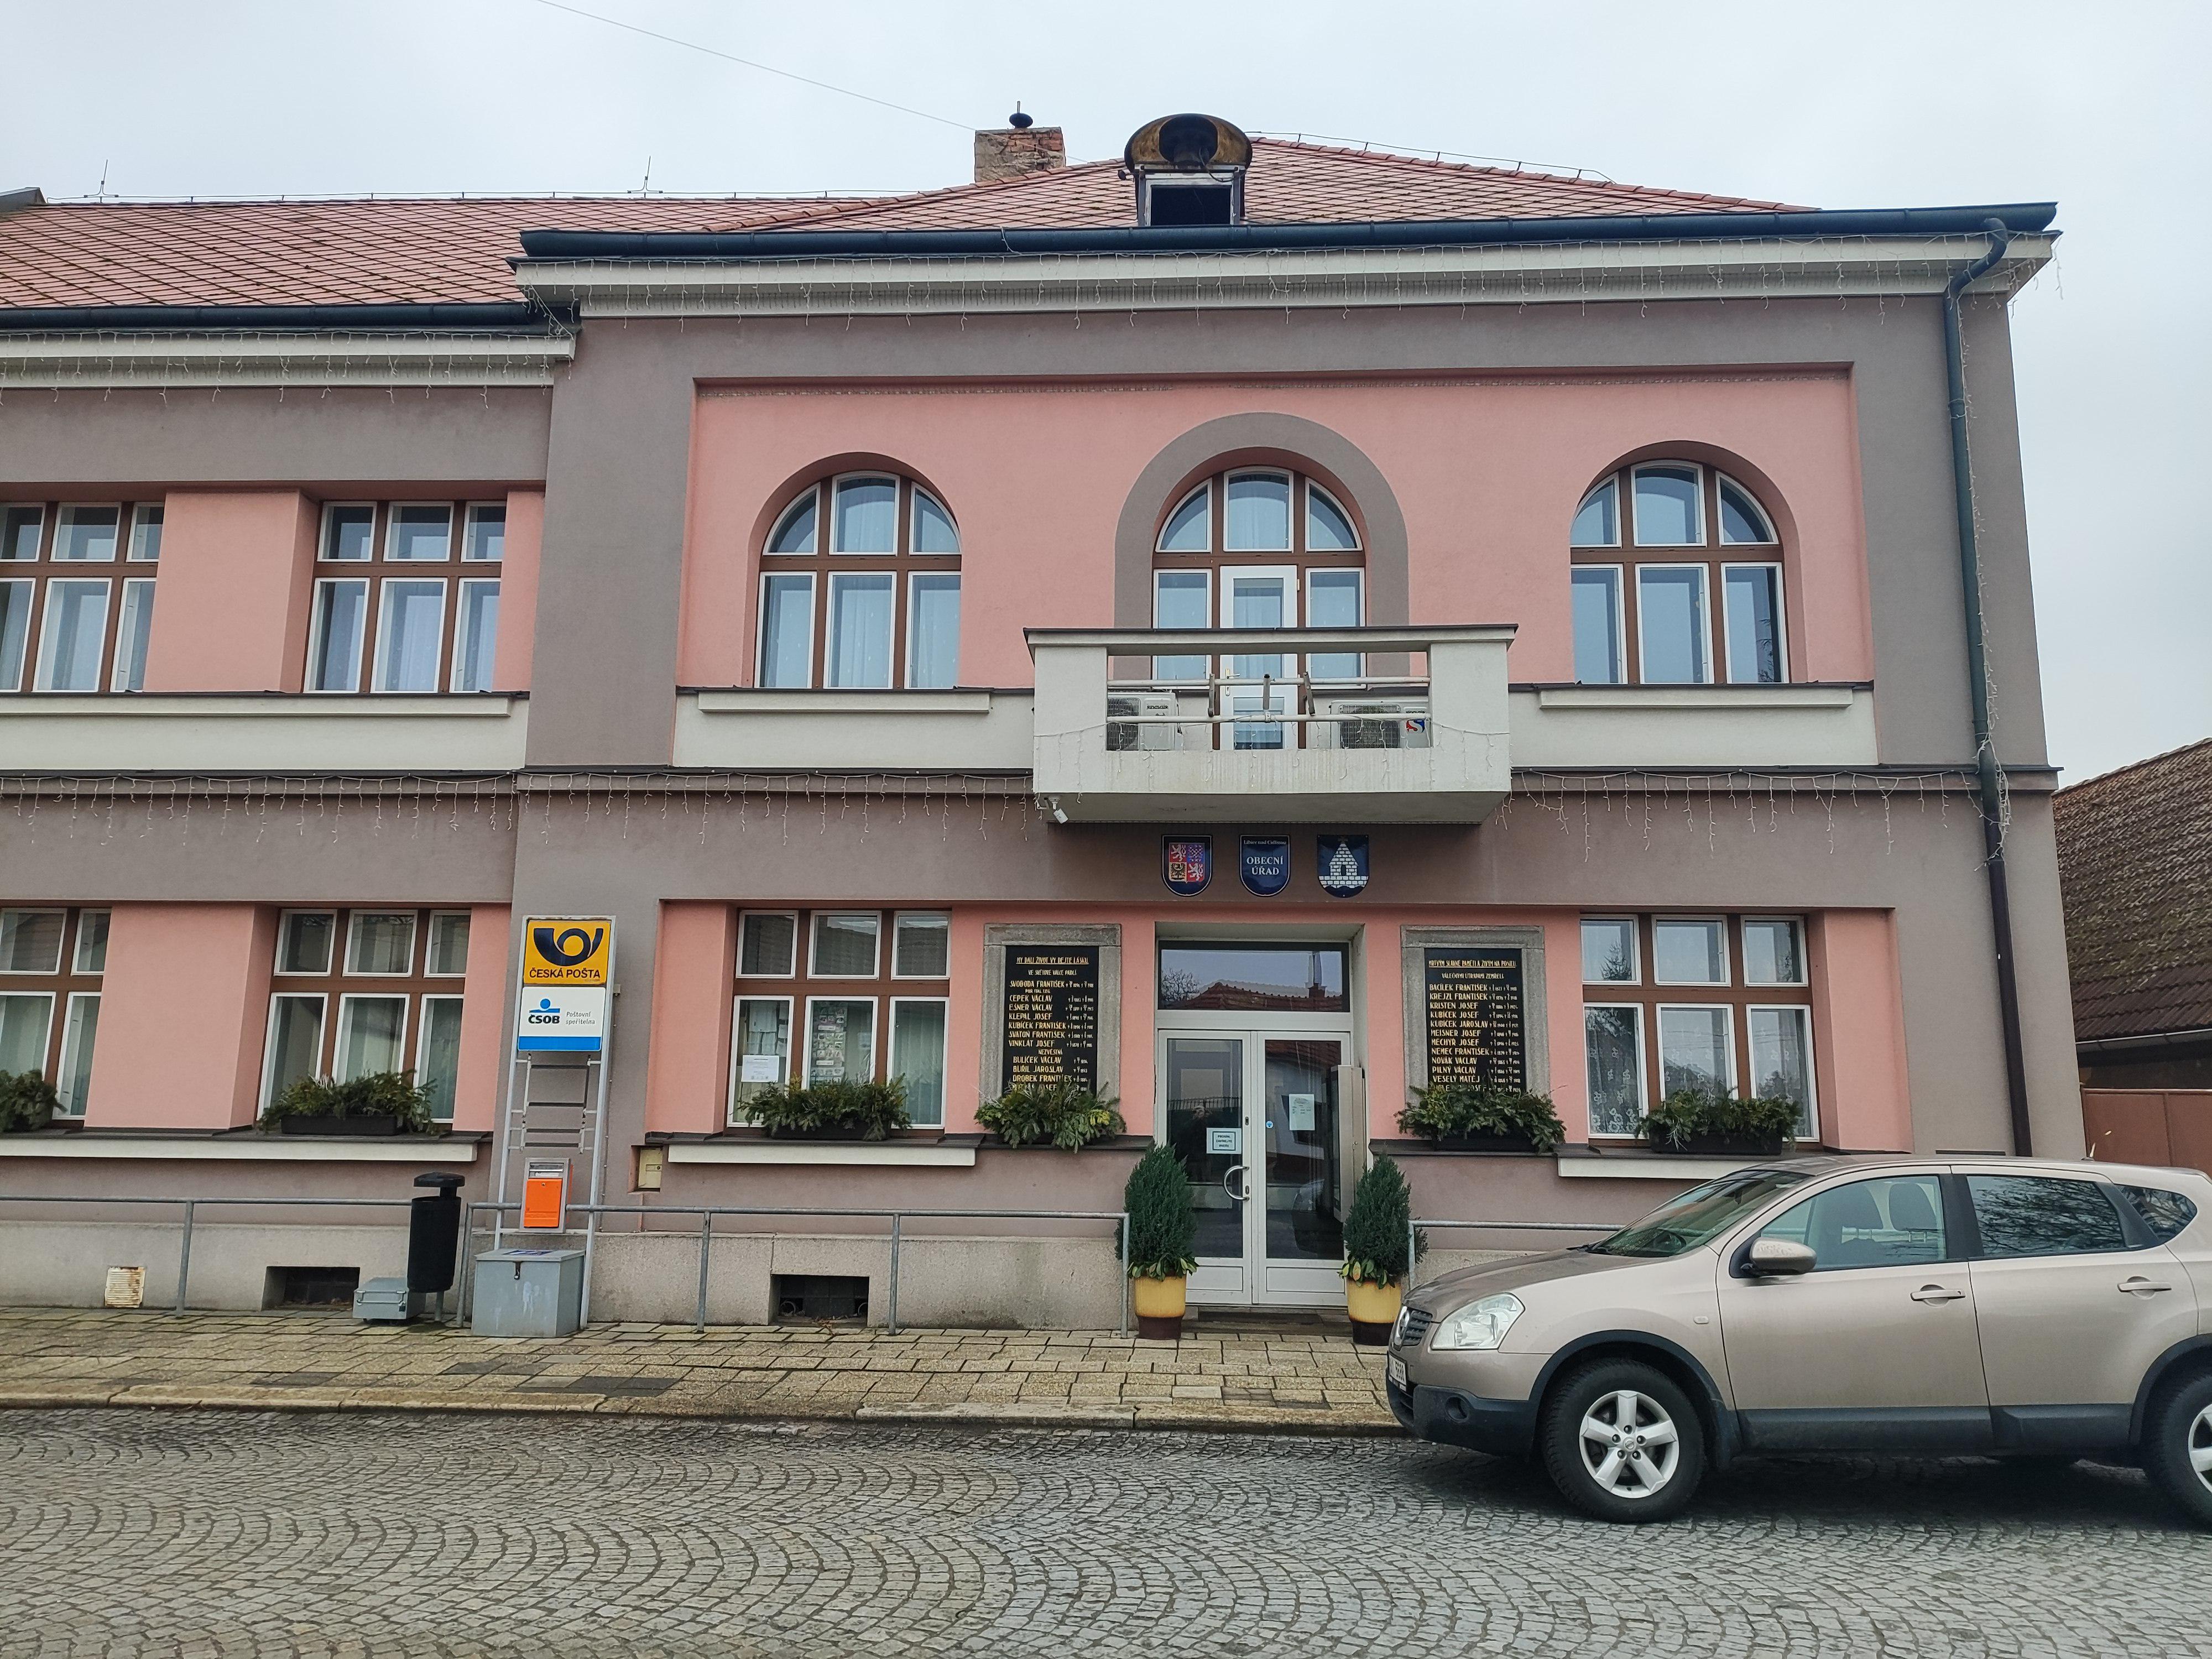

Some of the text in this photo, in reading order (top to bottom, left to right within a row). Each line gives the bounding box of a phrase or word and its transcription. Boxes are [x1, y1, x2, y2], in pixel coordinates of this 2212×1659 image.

[1246, 855, 1284, 865] OBECNÍ
[1251, 865, 1280, 875] ÚŘAD
[529, 967, 601, 978] ČESKÁ POŠTA
[528, 1013, 560, 1024] ČSOB
[1459, 1020, 1488, 1028] JAROSLAV
